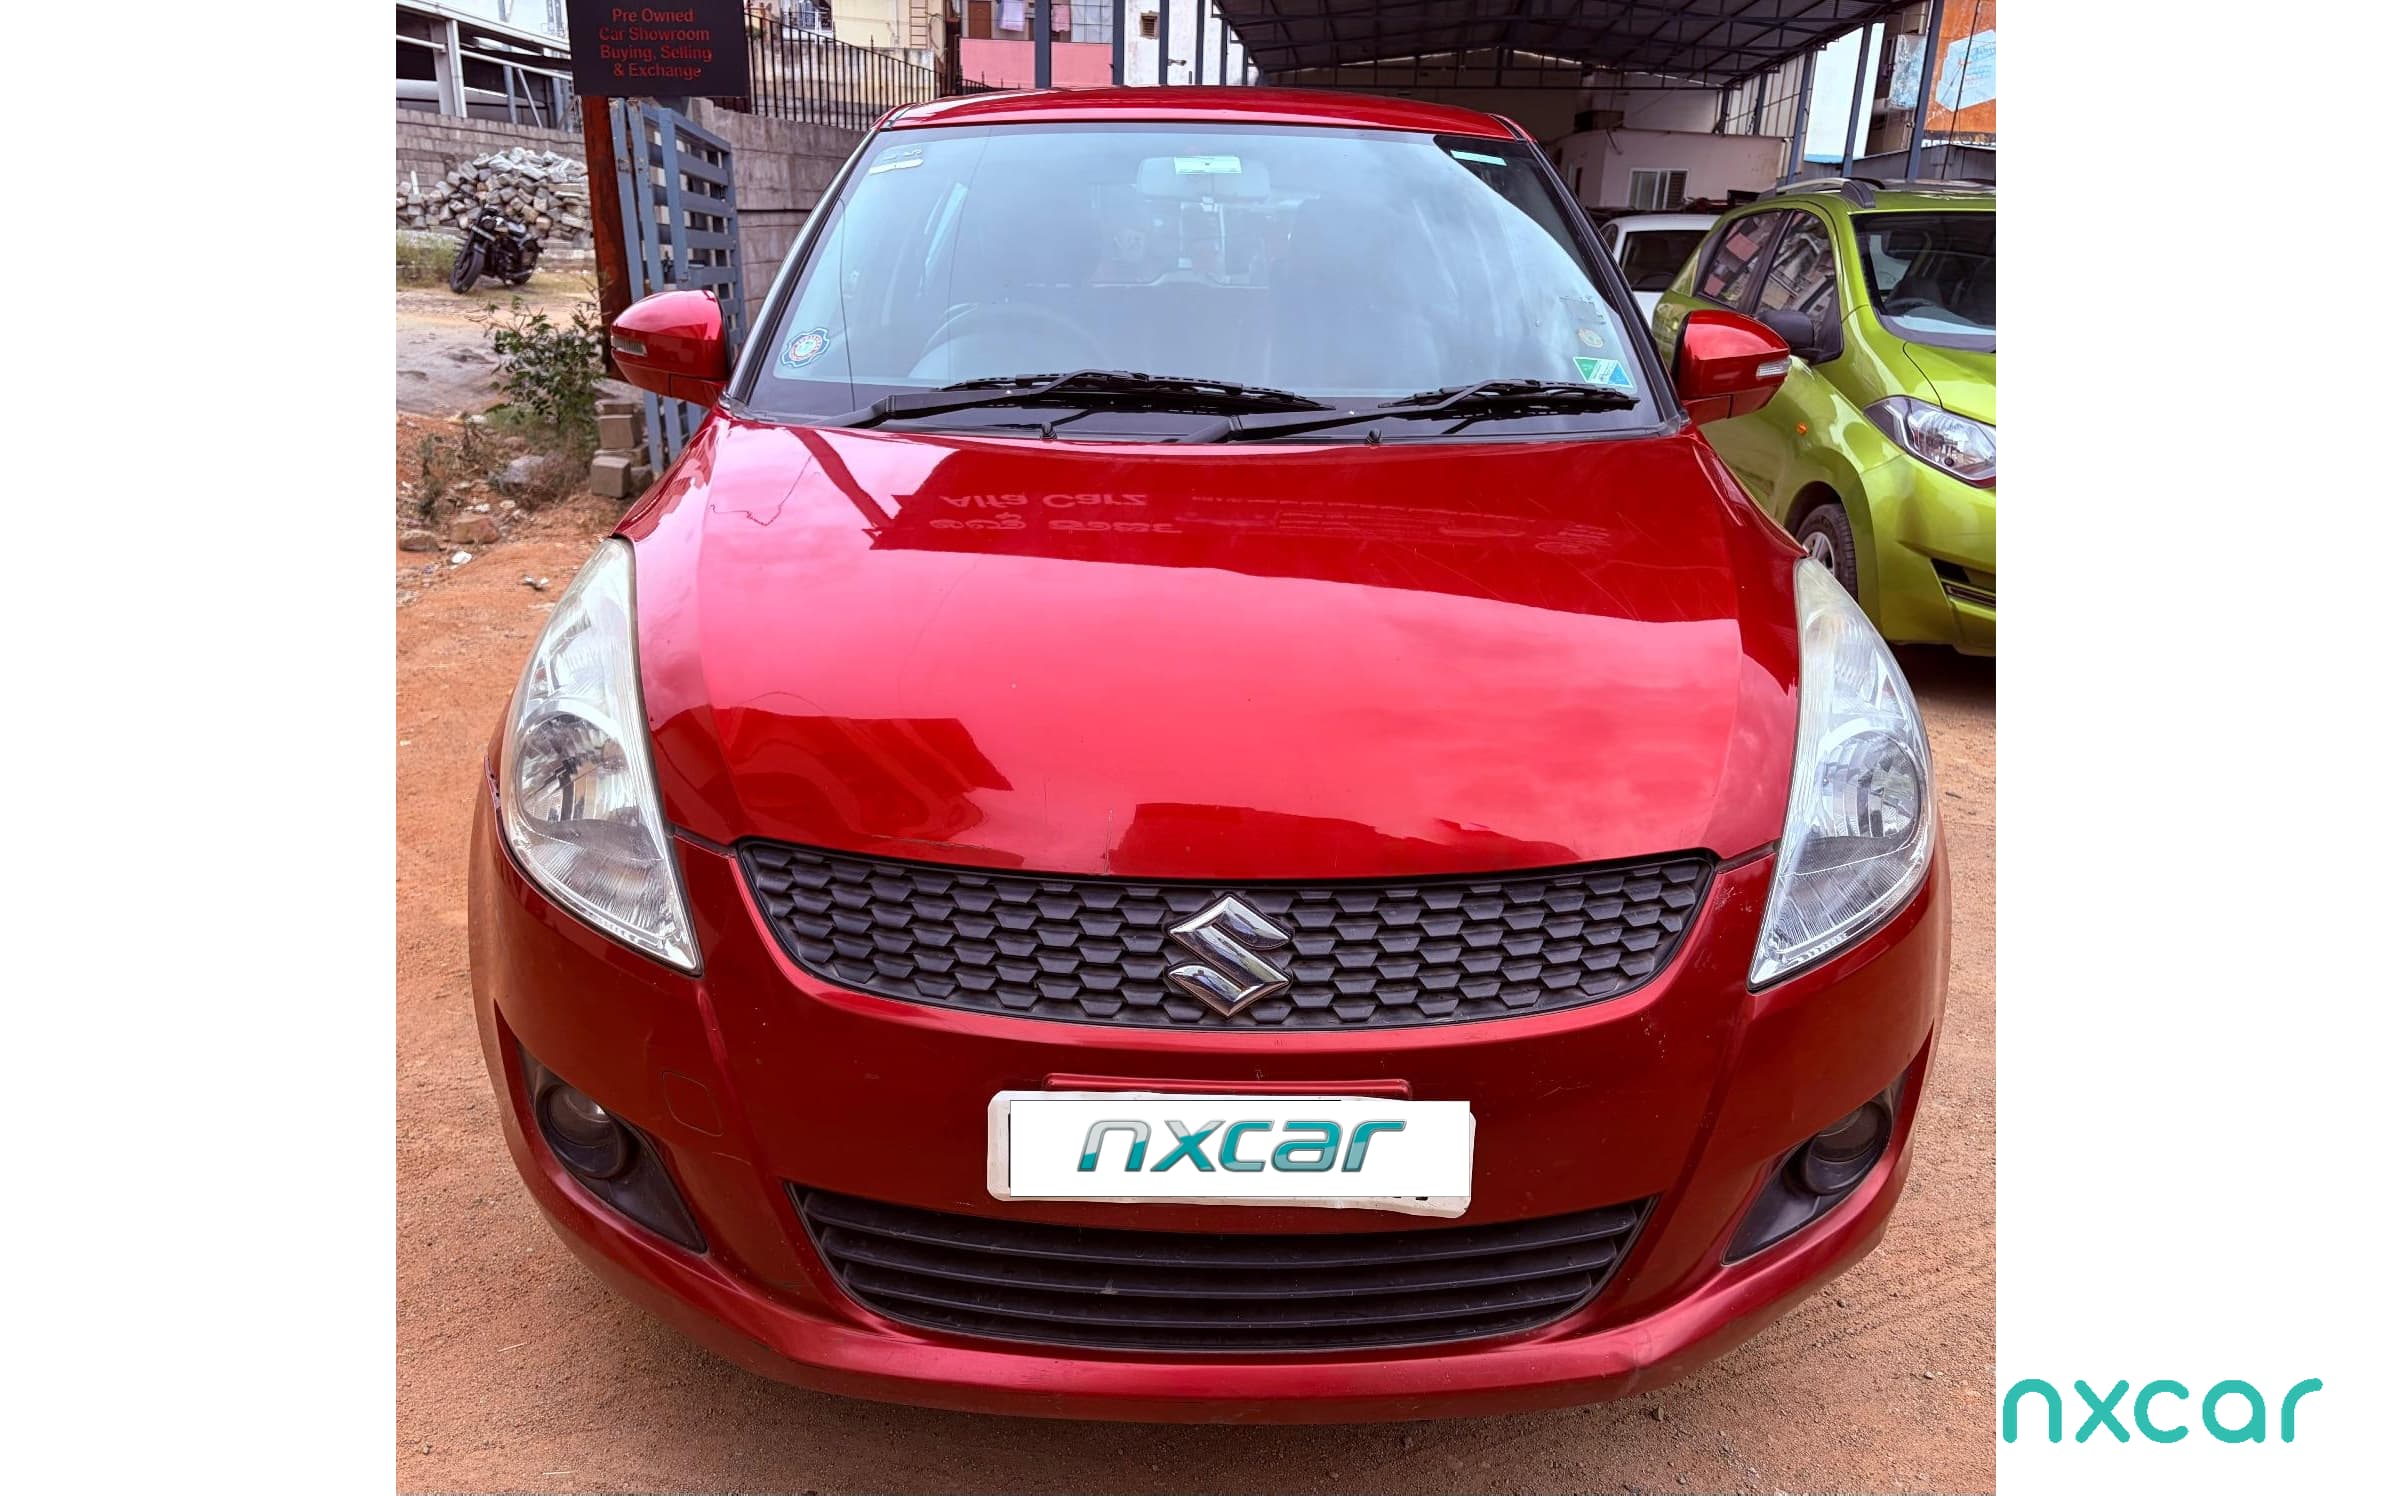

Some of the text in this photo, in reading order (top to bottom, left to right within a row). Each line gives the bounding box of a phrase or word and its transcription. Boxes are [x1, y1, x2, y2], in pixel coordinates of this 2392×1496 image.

[612, 8, 694, 22] Pre Owned
[600, 26, 710, 41] Car Showroom
[600, 44, 713, 63] Buying, Selling
[613, 63, 702, 80] & Exchange
